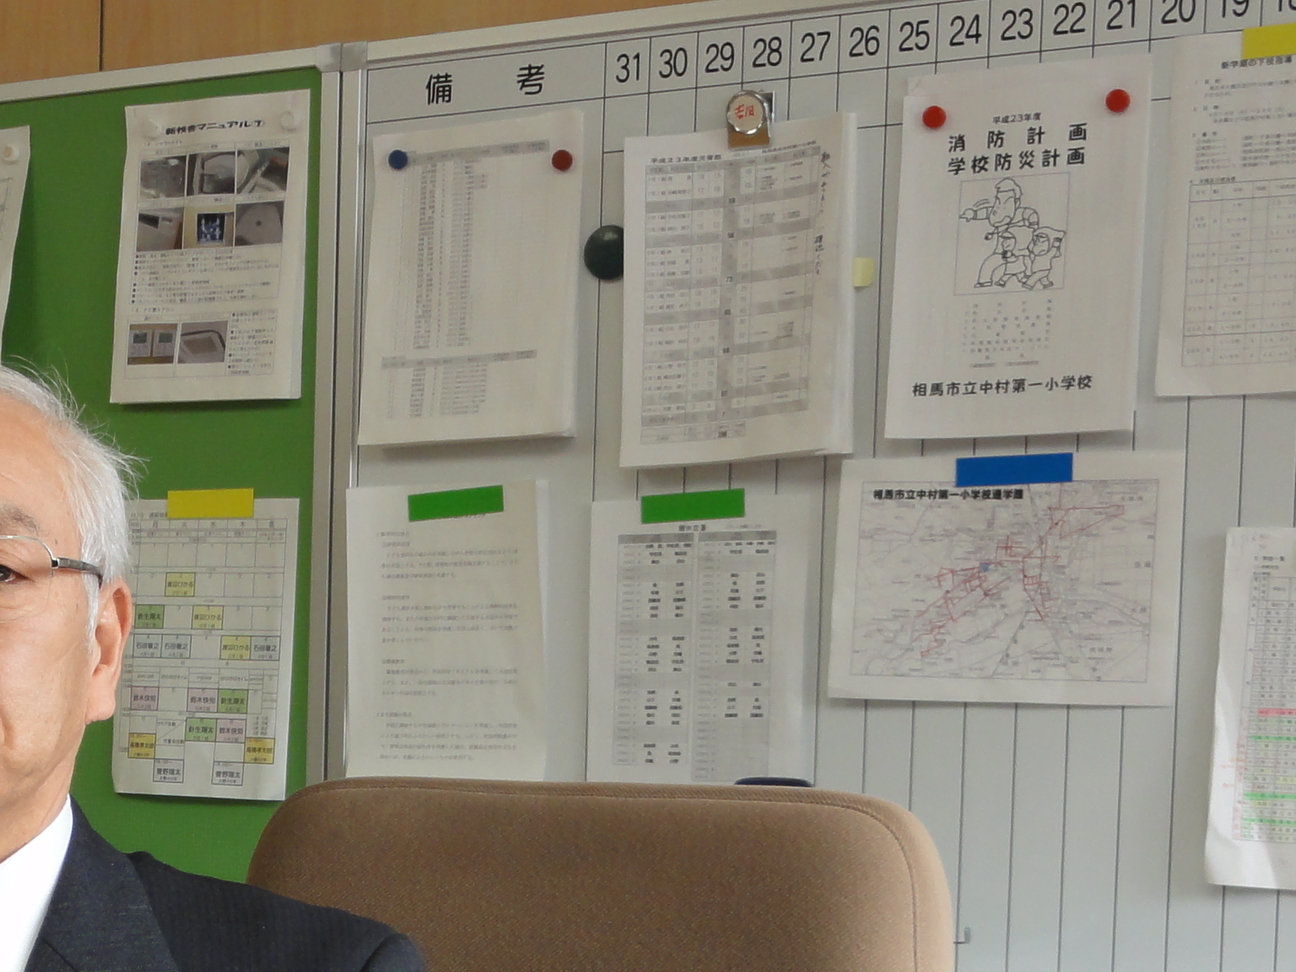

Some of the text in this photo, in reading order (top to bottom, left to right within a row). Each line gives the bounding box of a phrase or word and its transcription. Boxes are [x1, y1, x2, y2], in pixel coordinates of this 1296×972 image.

[1000, 8, 1034, 41] 23
[1053, 2, 1086, 35] 22
[1106, 0, 1136, 30] 21
[1161, 0, 1196, 24] 20
[849, 25, 880, 58] 26
[898, 20, 930, 52] 25
[949, 13, 982, 47] 24
[658, 47, 688, 79] 30
[705, 41, 735, 73] 29
[752, 36, 783, 68] 28
[800, 31, 831, 63] 27
[615, 52, 641, 83] 31
[948, 122, 1088, 153] 消防計画
[947, 146, 1086, 176] 学校防災計画
[912, 374, 1093, 399] 相馬市立中村第一小学校
